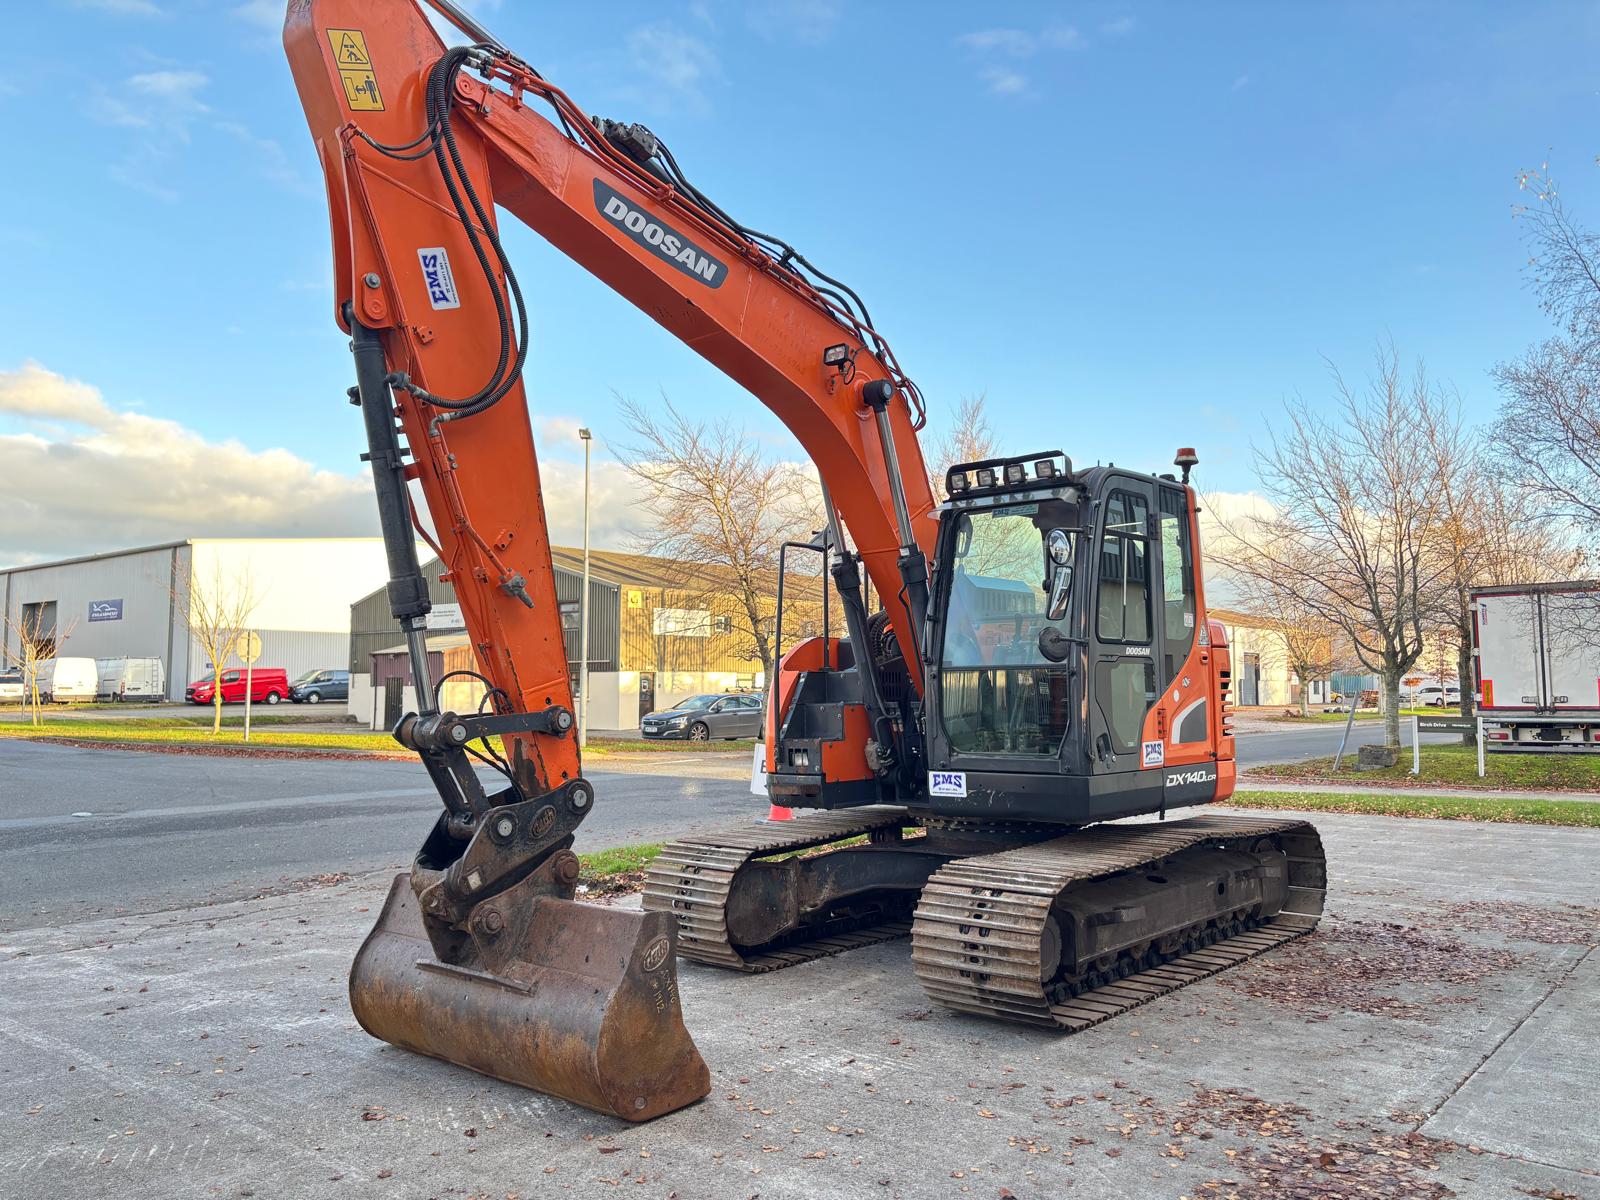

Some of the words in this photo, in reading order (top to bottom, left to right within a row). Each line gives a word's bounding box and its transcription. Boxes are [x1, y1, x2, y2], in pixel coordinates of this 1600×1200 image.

[603, 196, 718, 282] DOOSAN
[421, 254, 451, 303] EMS
[1126, 647, 1150, 655] DOOSAN
[1145, 743, 1162, 758] EMS
[932, 773, 962, 788] EMS
